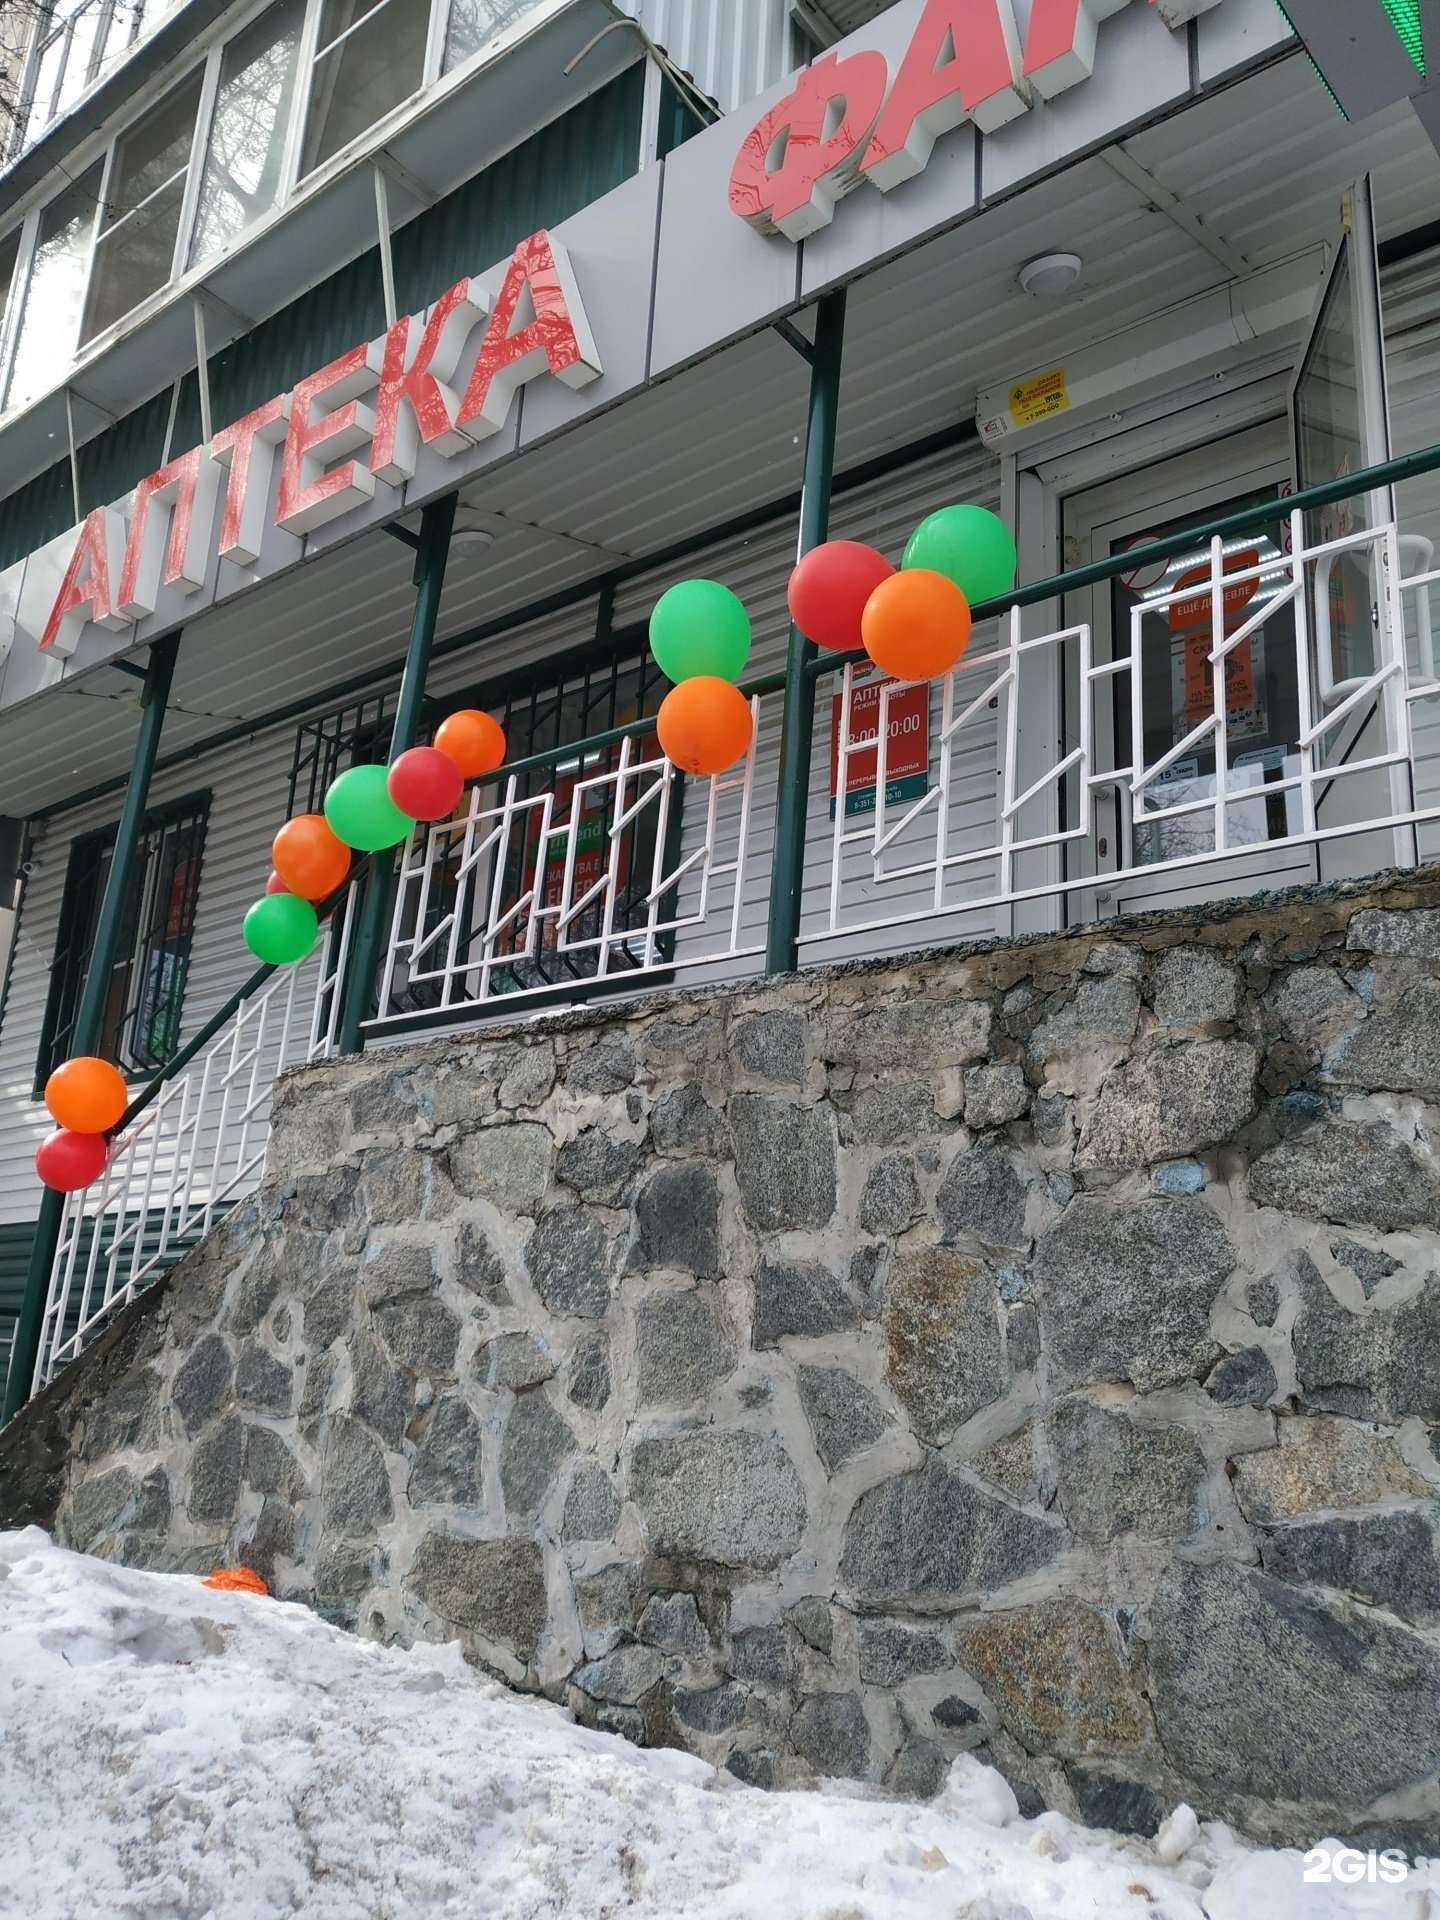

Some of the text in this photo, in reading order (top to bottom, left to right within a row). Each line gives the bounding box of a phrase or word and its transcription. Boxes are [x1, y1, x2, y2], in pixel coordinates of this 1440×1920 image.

[729, 0, 1222, 242] ФА
[37, 229, 602, 658] АПТЕКА
[1201, 586, 1251, 610] ДЕВЛЕ
[854, 680, 896, 705] АПТ
